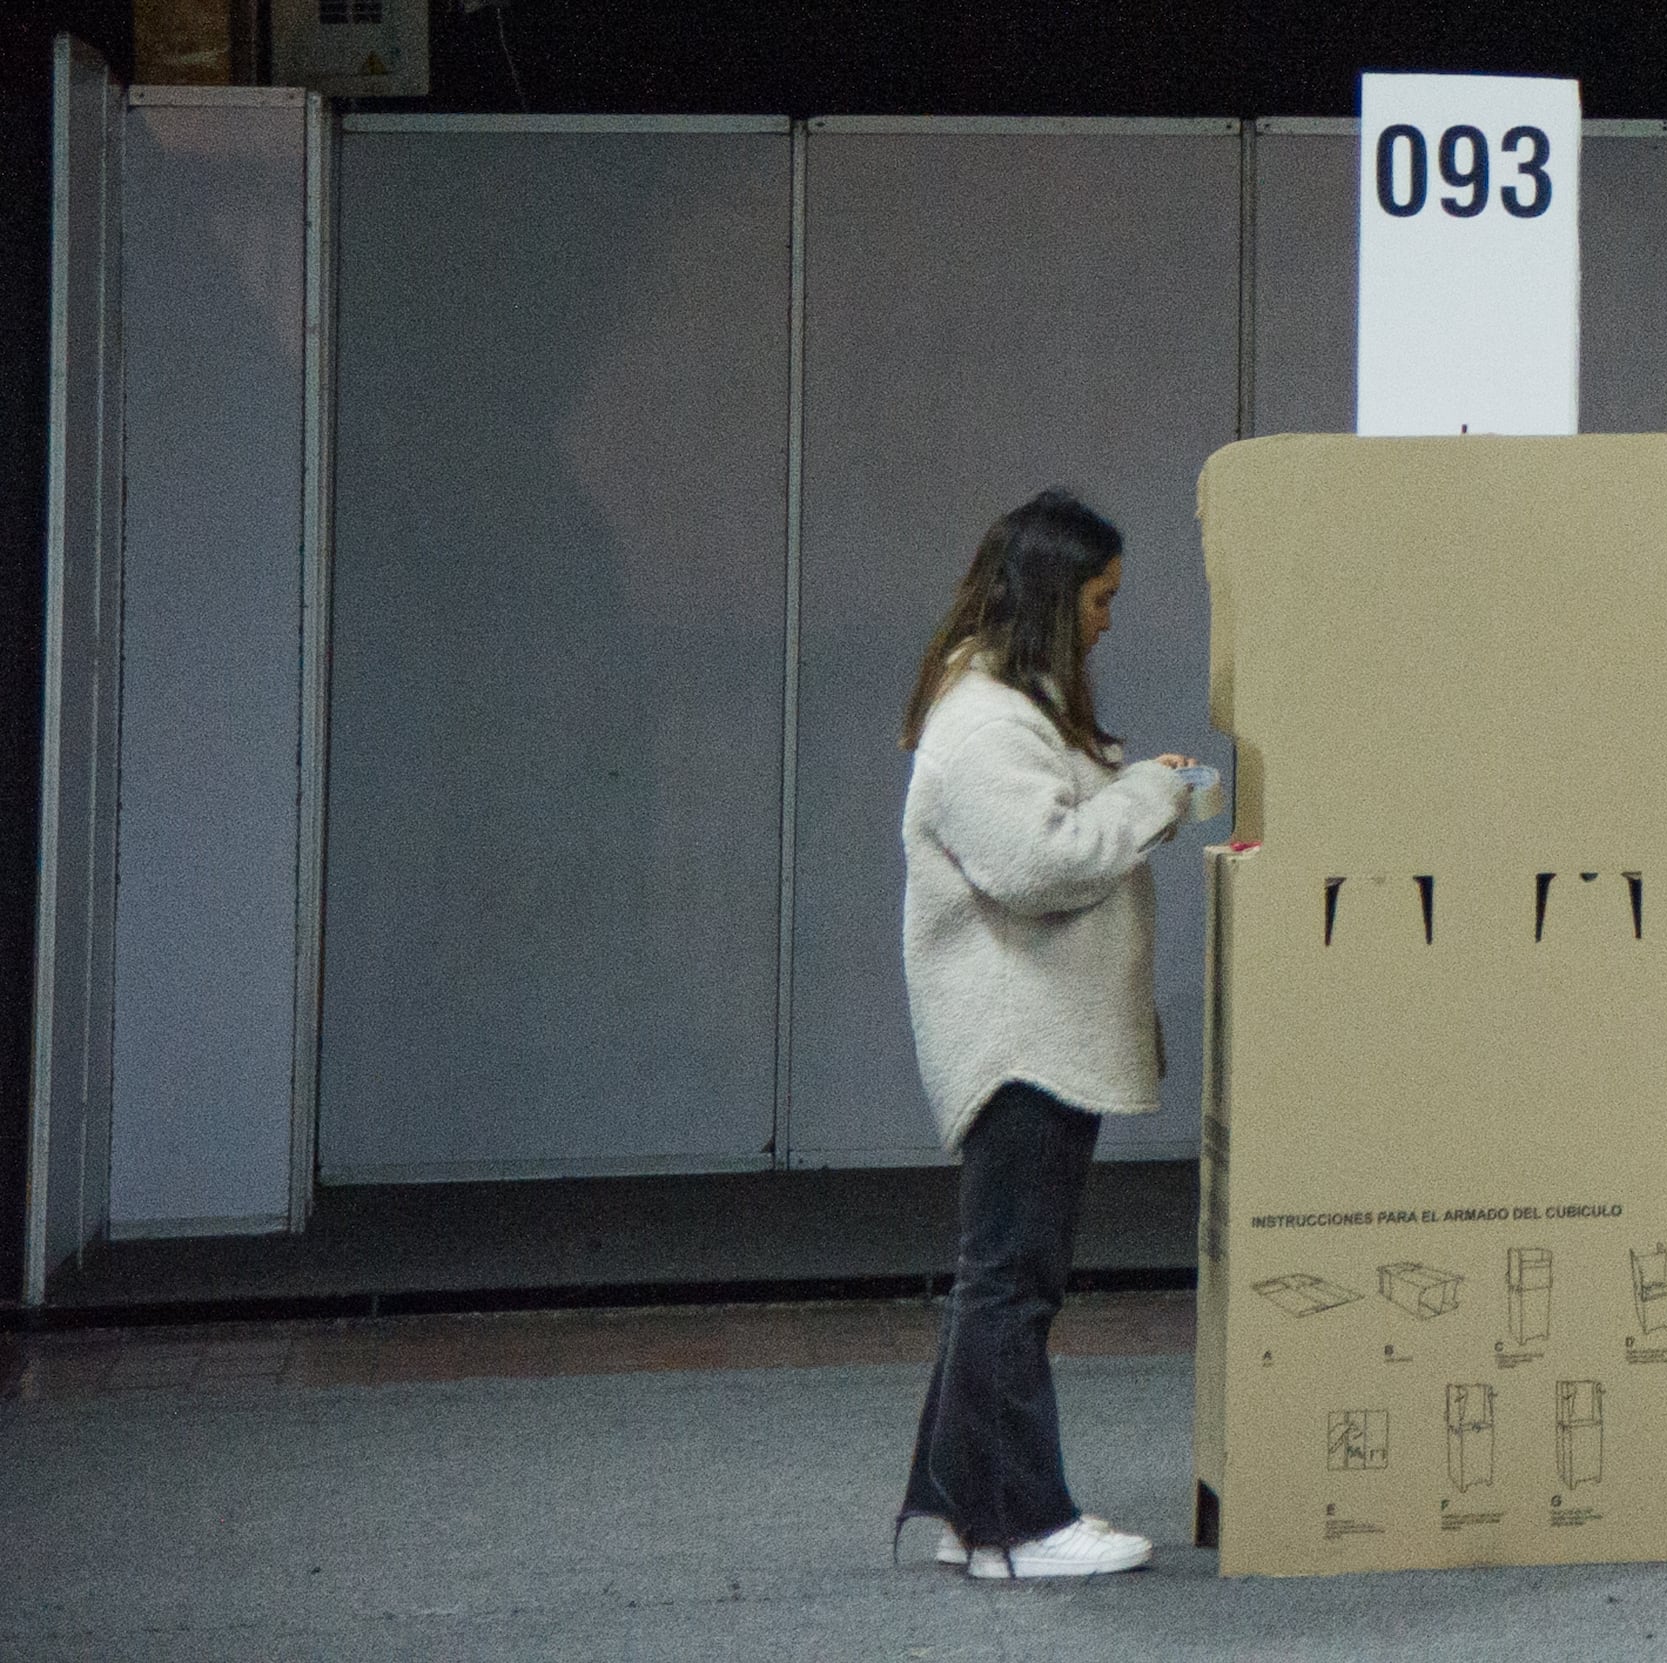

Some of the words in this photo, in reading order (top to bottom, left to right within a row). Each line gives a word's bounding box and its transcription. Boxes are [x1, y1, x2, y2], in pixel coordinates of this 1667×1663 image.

[1376, 123, 1553, 219] 093
[1252, 1211, 1373, 1228] INSTRUCCIONES
[1377, 1210, 1417, 1224] PARA
[1421, 1210, 1439, 1223] EL
[1443, 1207, 1509, 1222] ARMADO
[1513, 1206, 1541, 1220] DEL
[1545, 1204, 1622, 1219] CUBICULO
[1494, 1341, 1504, 1352] C
[1625, 1336, 1635, 1347] D
[1326, 1503, 1336, 1515] E
[1440, 1498, 1451, 1511] F
